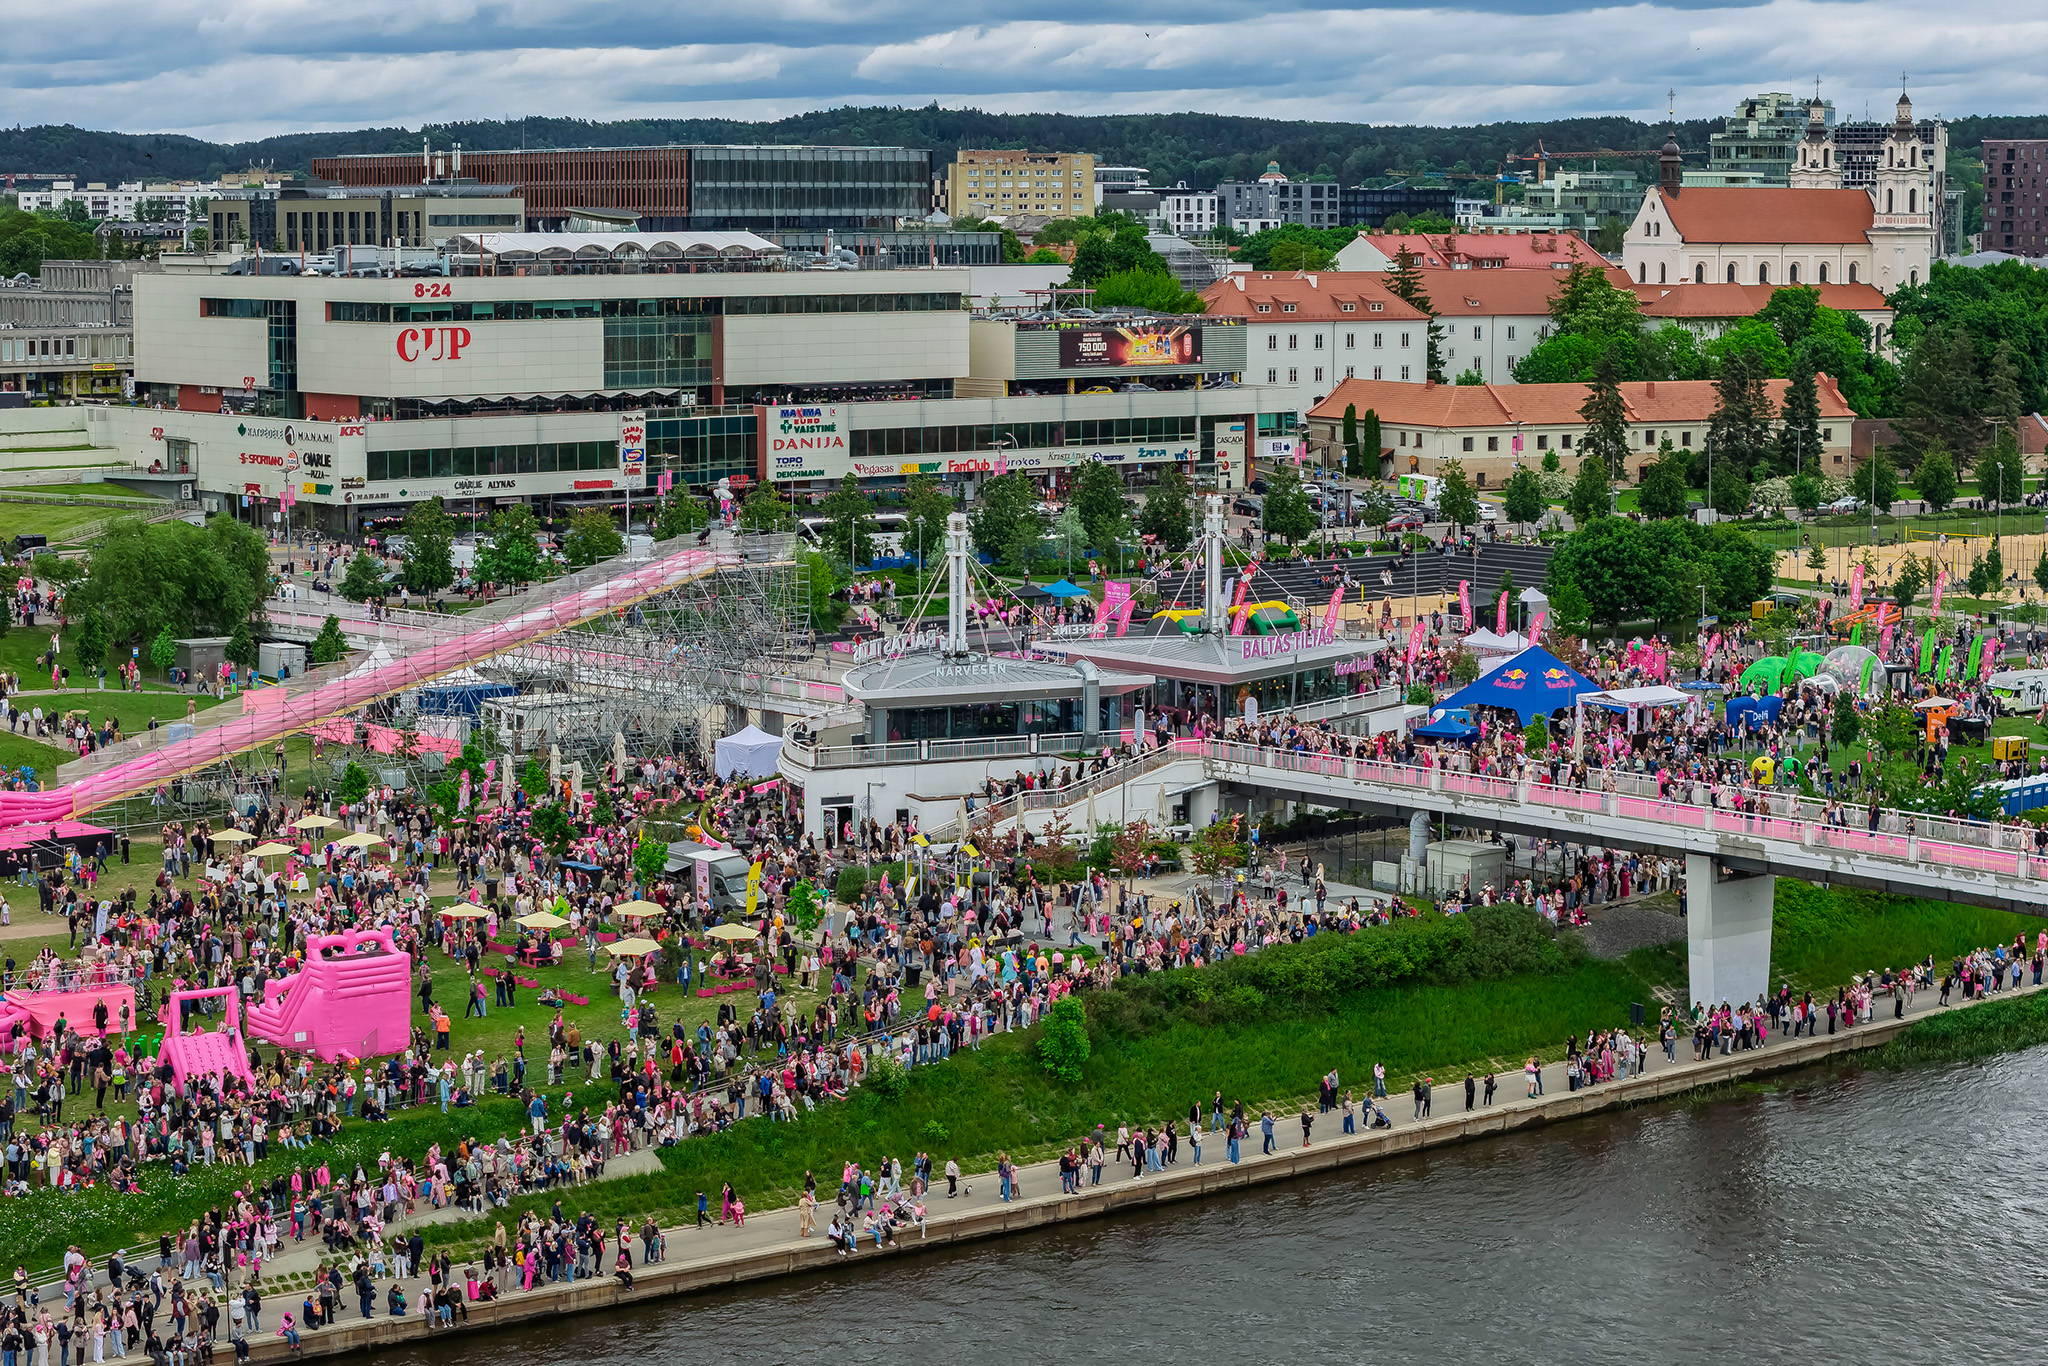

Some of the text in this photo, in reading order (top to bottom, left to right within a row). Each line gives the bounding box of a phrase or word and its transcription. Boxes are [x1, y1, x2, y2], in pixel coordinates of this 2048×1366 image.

[414, 283, 452, 298] 8-24
[397, 327, 471, 362] CUP
[1078, 342, 1107, 352] 750 000
[780, 408, 822, 418] MAXIMA
[339, 426, 365, 437] KFC
[622, 426, 644, 435] CANDY
[298, 432, 334, 443] MANAMI
[625, 434, 642, 445] POP
[773, 436, 844, 450] DANIJA
[1216, 436, 1244, 444] CASCADA
[302, 452, 332, 468] CHARLIE
[948, 458, 990, 472] FanClub
[858, 463, 895, 475] Pegasas
[900, 461, 942, 474] SUBWAY
[310, 470, 324, 479] PIZZA
[776, 470, 824, 478] DEICHMANN
[454, 480, 483, 490] CHARLIE
[487, 480, 516, 489] ALYNAS
[1242, 626, 1335, 659] BALTAS TILTAS
[935, 664, 1006, 677] NARVESEN
[1335, 655, 1375, 676] food hall
[1493, 678, 1526, 690] Red Bull
[1545, 678, 1578, 690] Red Bull
[1753, 710, 1769, 721] Delfi
